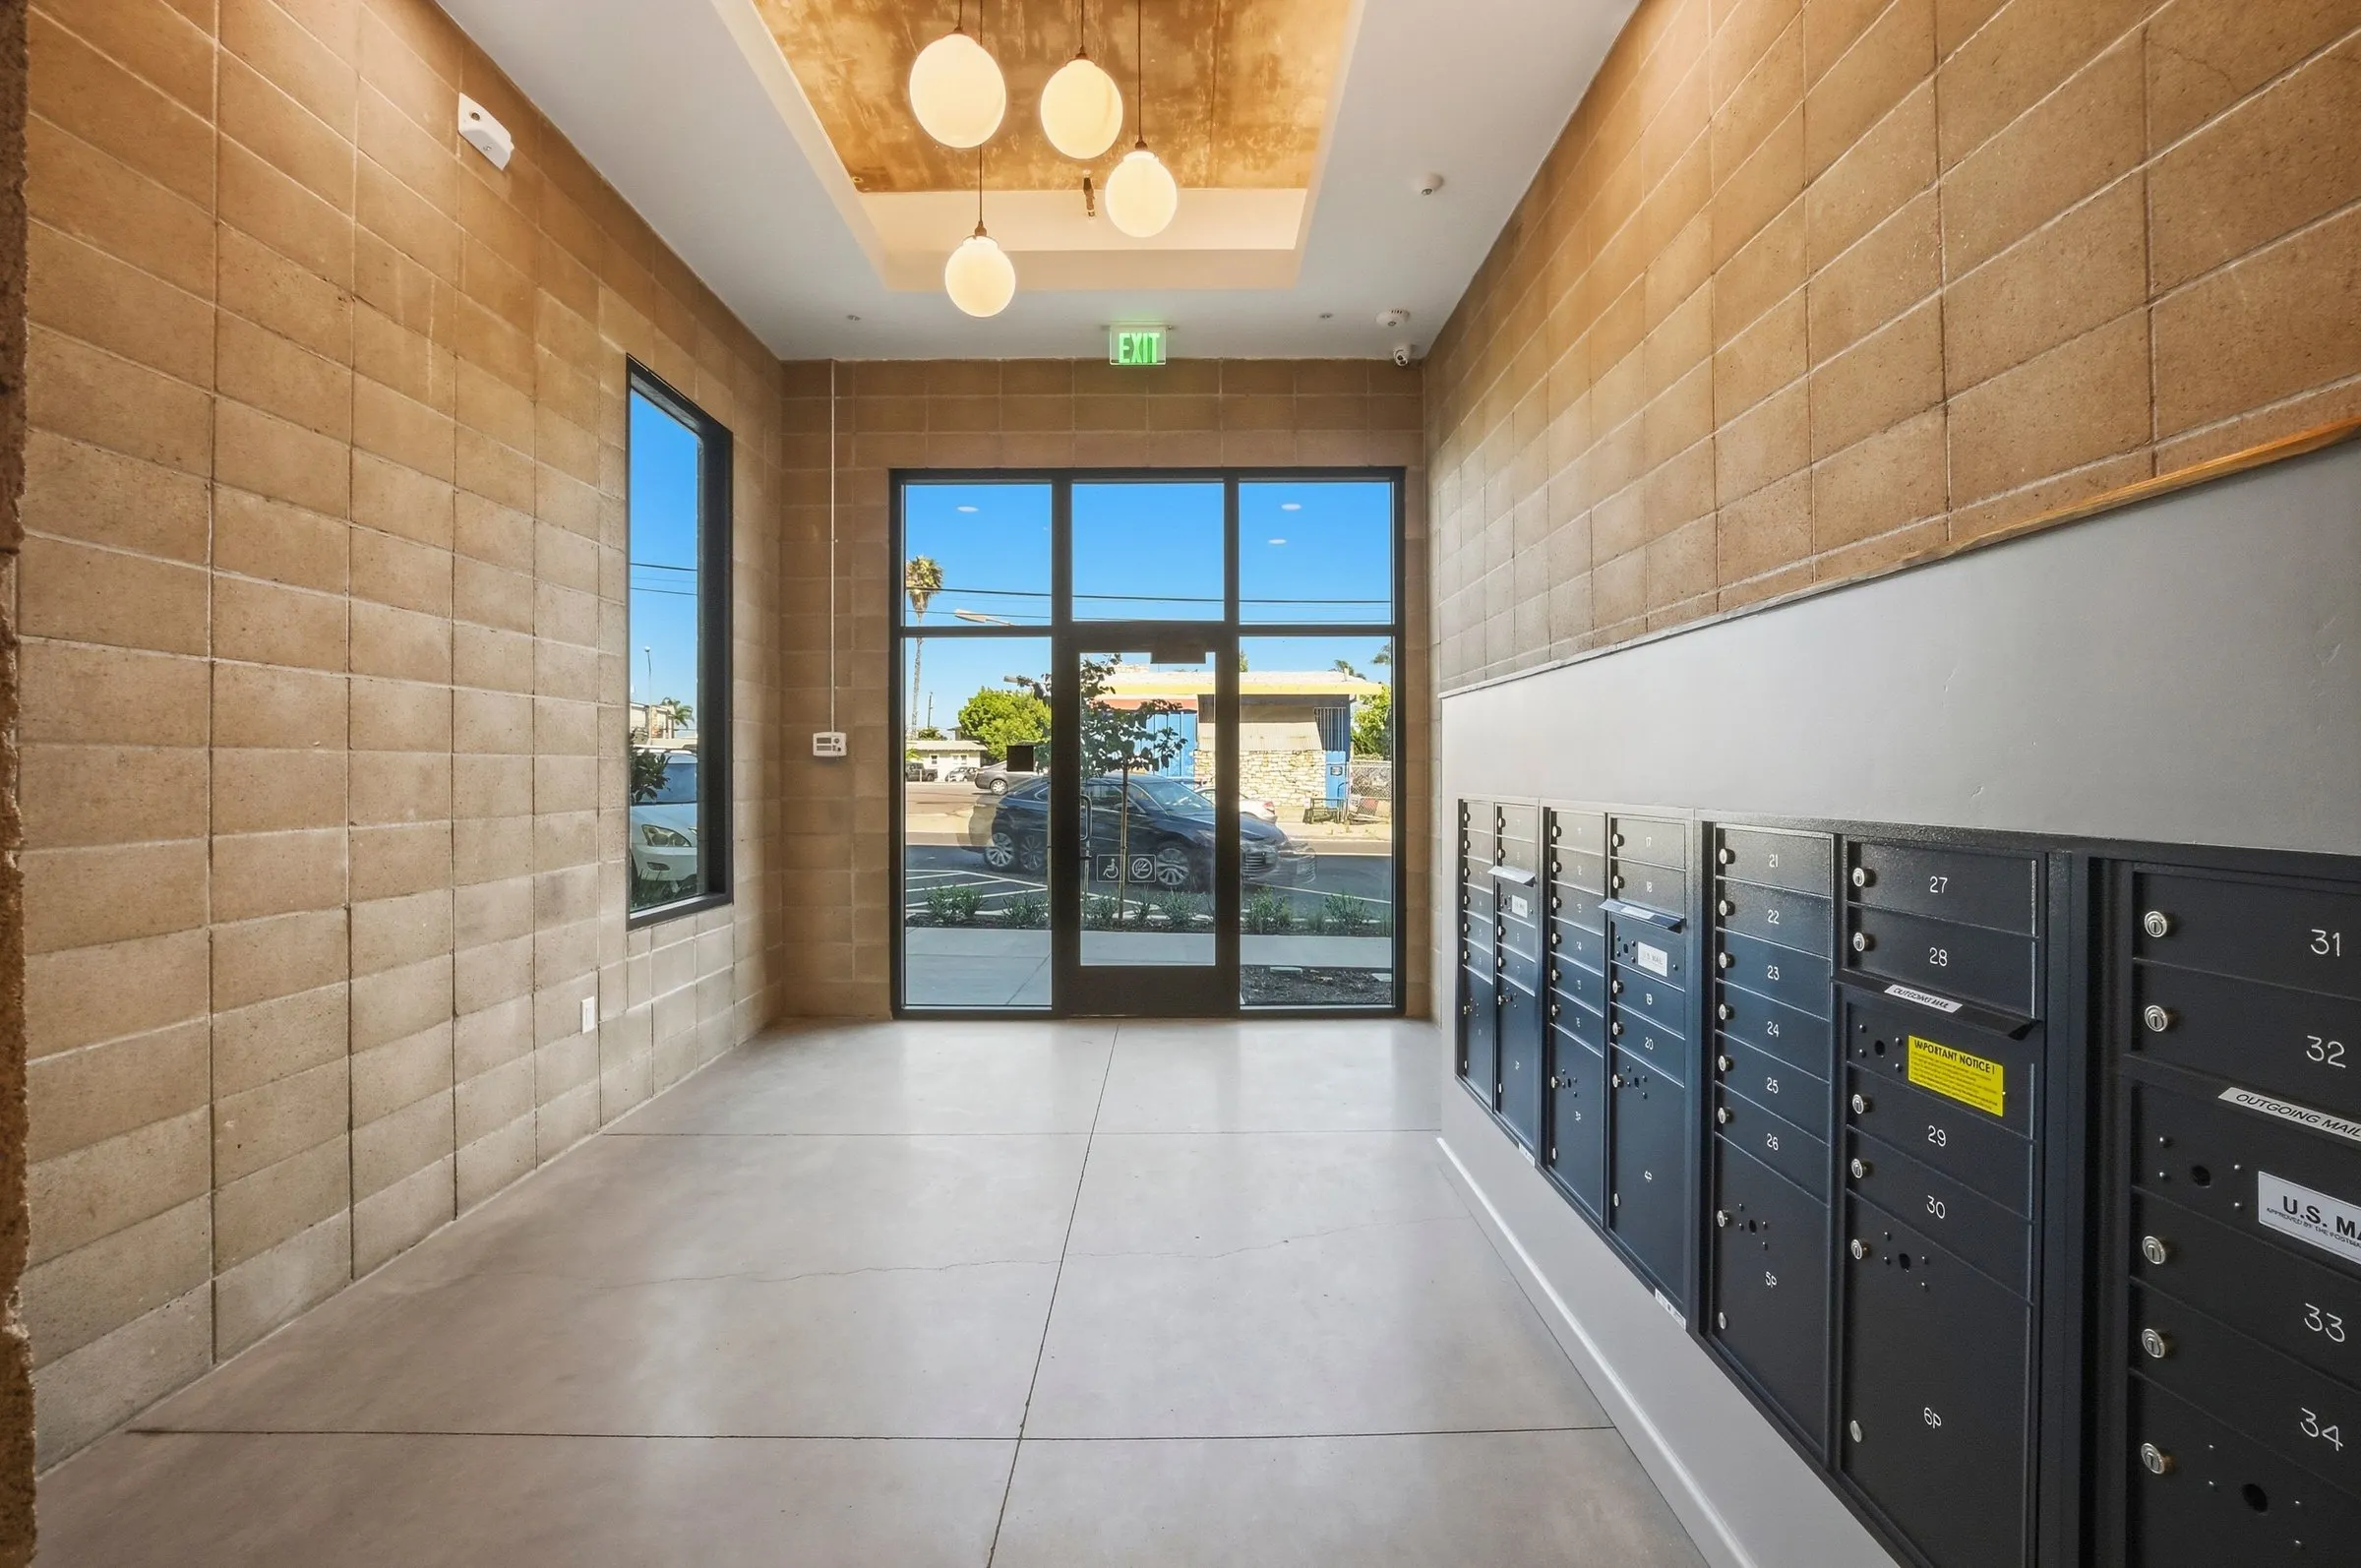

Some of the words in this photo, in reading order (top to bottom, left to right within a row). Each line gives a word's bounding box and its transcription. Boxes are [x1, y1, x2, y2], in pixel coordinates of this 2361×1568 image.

[1119, 332, 1160, 364] EXIT
[1769, 854, 1779, 868] 21
[1929, 875, 1948, 893] 27
[1768, 909, 1780, 925] 22
[2310, 929, 2341, 957] 31
[1929, 947, 1948, 967] 28
[1768, 965, 1780, 981] 23
[1767, 1021, 1780, 1037] 24
[1913, 1040, 1958, 1061] IMPORTANT
[2306, 1035, 2346, 1068] 32
[1766, 1077, 1779, 1094] 25
[2236, 1094, 2321, 1123] OUTGOING
[2322, 1118, 2361, 1137] MAIL
[1766, 1133, 1779, 1151] 26
[1927, 1124, 1947, 1147] 29
[1926, 1195, 1946, 1219] 30
[2283, 1195, 2328, 1228] U.S.
[2336, 1215, 2361, 1240] M
[2304, 1302, 2345, 1343] 33
[2300, 1407, 2343, 1451] 34
